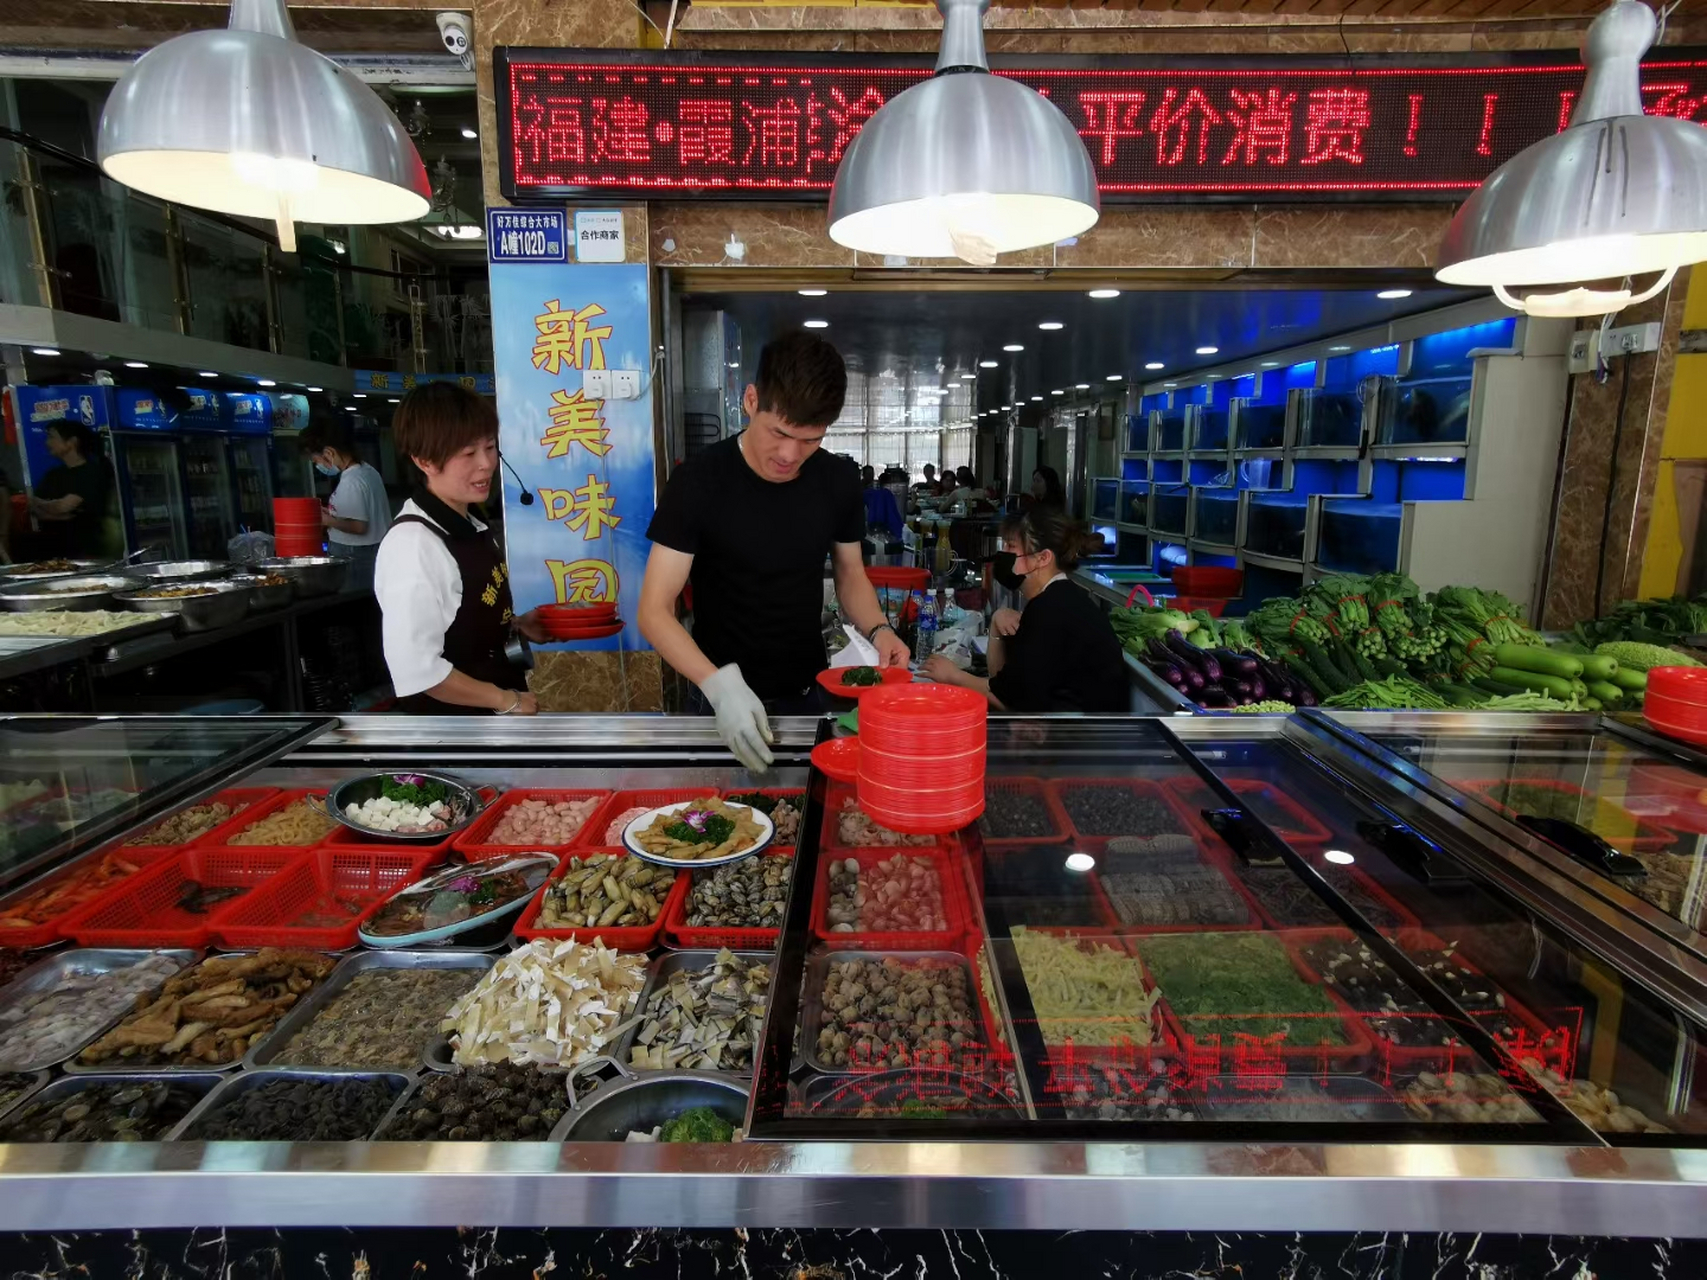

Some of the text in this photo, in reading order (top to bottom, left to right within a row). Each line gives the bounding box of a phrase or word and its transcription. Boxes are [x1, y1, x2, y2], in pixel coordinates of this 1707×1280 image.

[497, 215, 558, 229] 好万佳综合大市场
[580, 230, 619, 240] 合作商家
[531, 298, 622, 604] 新美味园
